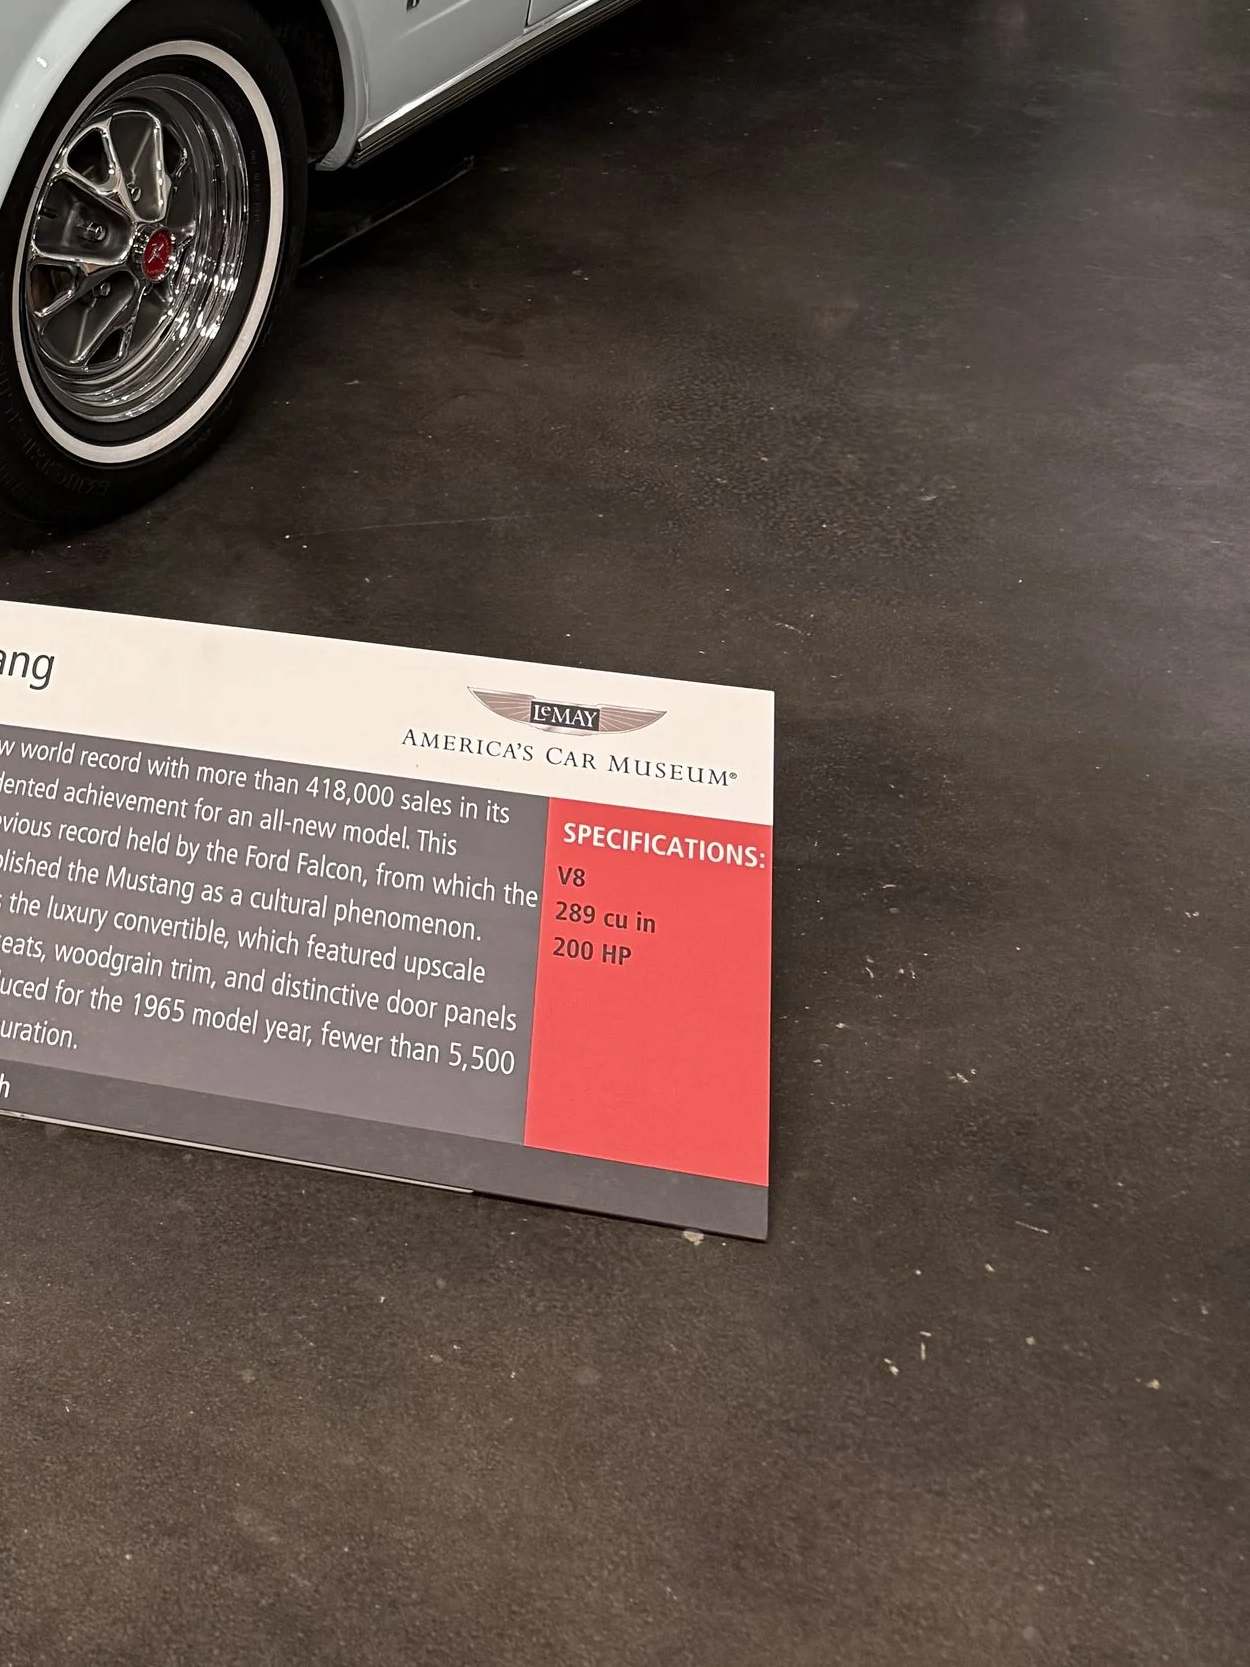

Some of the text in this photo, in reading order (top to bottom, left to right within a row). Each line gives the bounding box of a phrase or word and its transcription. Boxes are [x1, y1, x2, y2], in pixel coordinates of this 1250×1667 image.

[21, 740, 76, 764] world
[79, 750, 142, 773] record
[147, 756, 190, 780] with
[196, 765, 247, 788] more
[254, 768, 299, 795] than
[305, 776, 394, 808] 418,000
[400, 790, 452, 816] sales
[459, 795, 478, 820] in
[486, 799, 510, 824] its
[402, 728, 533, 762] AMERICA'S
[545, 747, 596, 770] CAR
[63, 782, 189, 819] achievement
[194, 797, 223, 823] for
[227, 808, 253, 828] an
[259, 808, 337, 839] all-new
[342, 823, 410, 850] model.
[417, 829, 457, 856] This
[563, 822, 765, 869] SPECIFICATIONS:
[58, 823, 122, 848] record
[126, 826, 171, 855] held
[175, 833, 201, 865] by
[206, 838, 238, 865] the
[245, 845, 290, 872] Ford
[296, 852, 368, 887] Falcon,
[375, 862, 425, 892] from
[432, 872, 495, 902] which
[503, 881, 538, 908] the
[67, 858, 99, 885] the
[105, 864, 195, 905] Mustang
[200, 884, 224, 903] as
[230, 888, 243, 906] a
[250, 887, 328, 919] cultural
[333, 898, 481, 941] phenomenon.
[557, 865, 586, 888] V8
[9, 890, 41, 917] the
[46, 894, 109, 933] luxury
[113, 912, 229, 949] convertible,
[237, 925, 299, 956] which
[306, 933, 397, 971] featured
[404, 955, 486, 984] upscale
[553, 936, 632, 966] 200 HP
[555, 901, 656, 934] 289 cu in
[55, 943, 163, 977] woodgrain
[170, 958, 216, 990] trim,
[224, 968, 266, 993] and
[271, 971, 379, 1011] distinctive
[386, 989, 438, 1019] door
[444, 1003, 517, 1032] panels
[54, 979, 85, 1007] for
[90, 985, 123, 1013] the
[134, 992, 185, 1023] 1965
[192, 1007, 259, 1035] model
[263, 1018, 312, 1047] year,
[321, 1020, 384, 1054] fewer
[389, 1032, 440, 1064] than
[448, 1042, 515, 1075] 5,500
